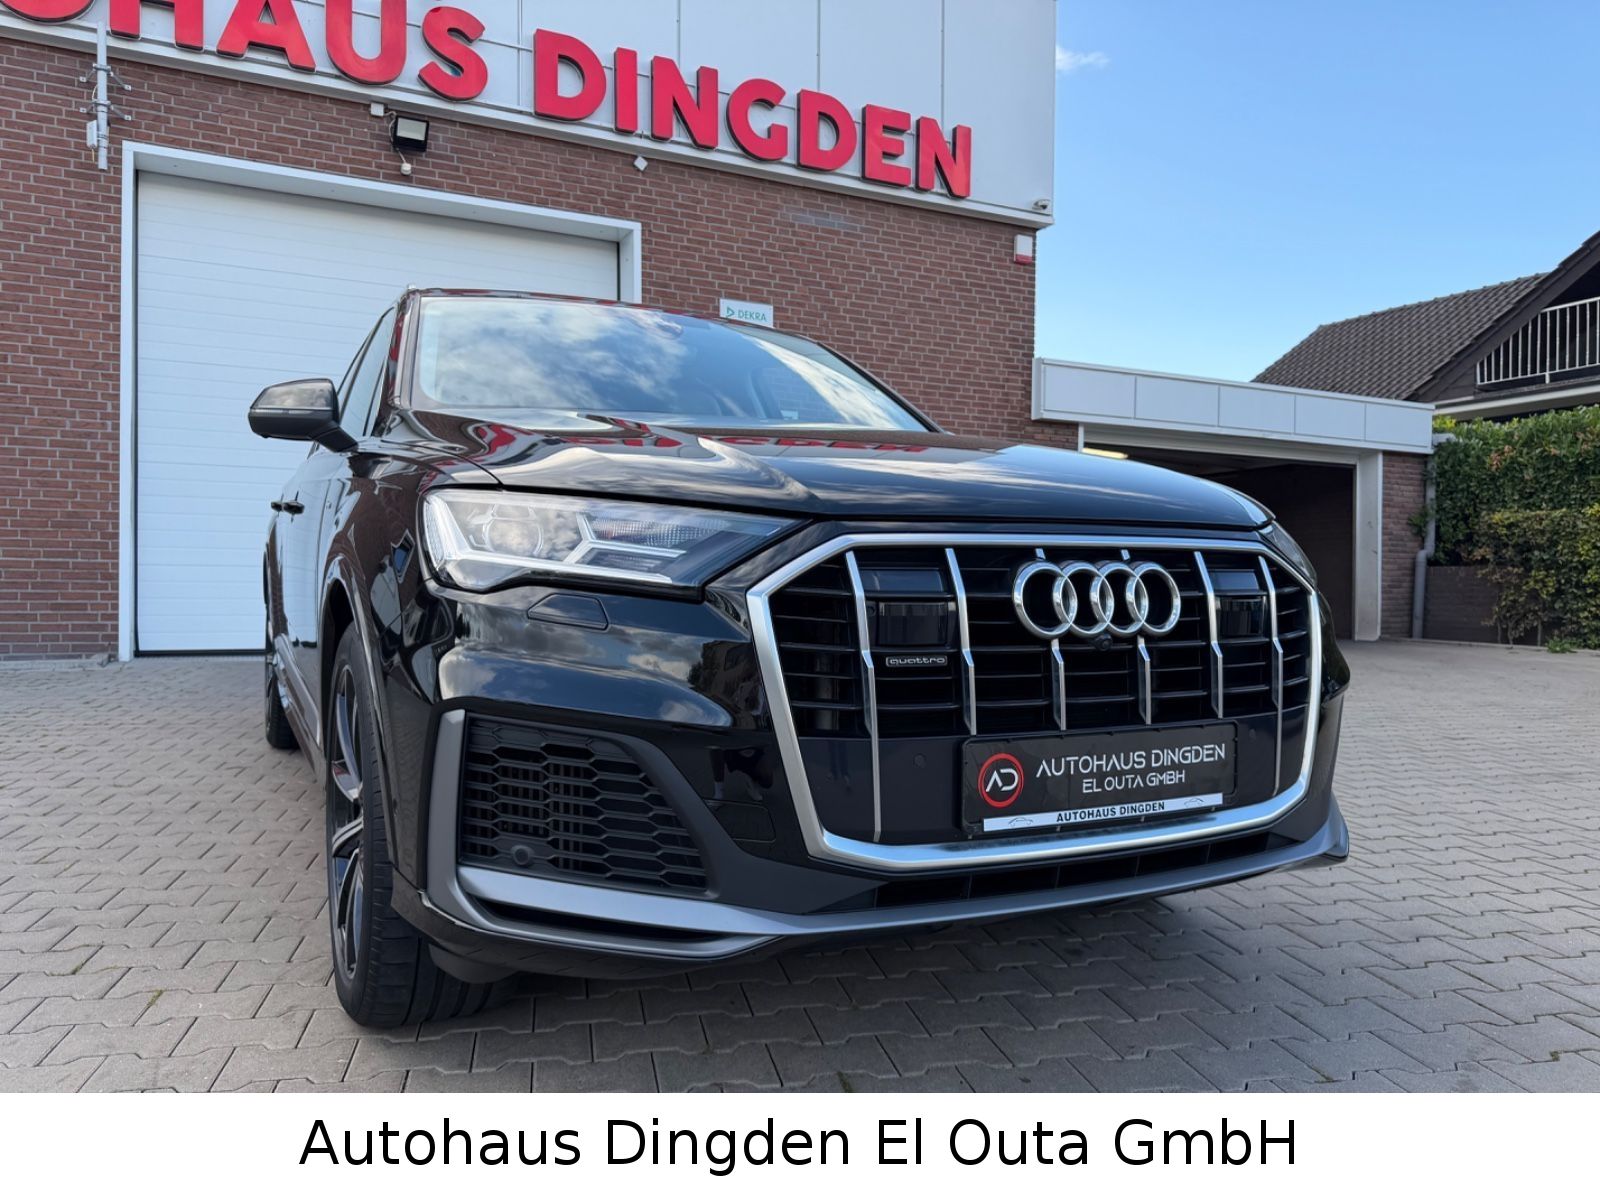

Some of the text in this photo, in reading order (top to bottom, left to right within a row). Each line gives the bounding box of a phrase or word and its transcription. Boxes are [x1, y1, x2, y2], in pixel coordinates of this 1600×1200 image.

[533, 28, 972, 198] DINGDEN
[737, 308, 768, 322] DEKRA
[889, 656, 946, 666] quattro
[1036, 743, 1225, 778] AUTOHAUS DINGDEN
[1082, 770, 1185, 793] EL OUTA GMBH
[1056, 801, 1165, 823] AUTOHAUS DINGDEN
